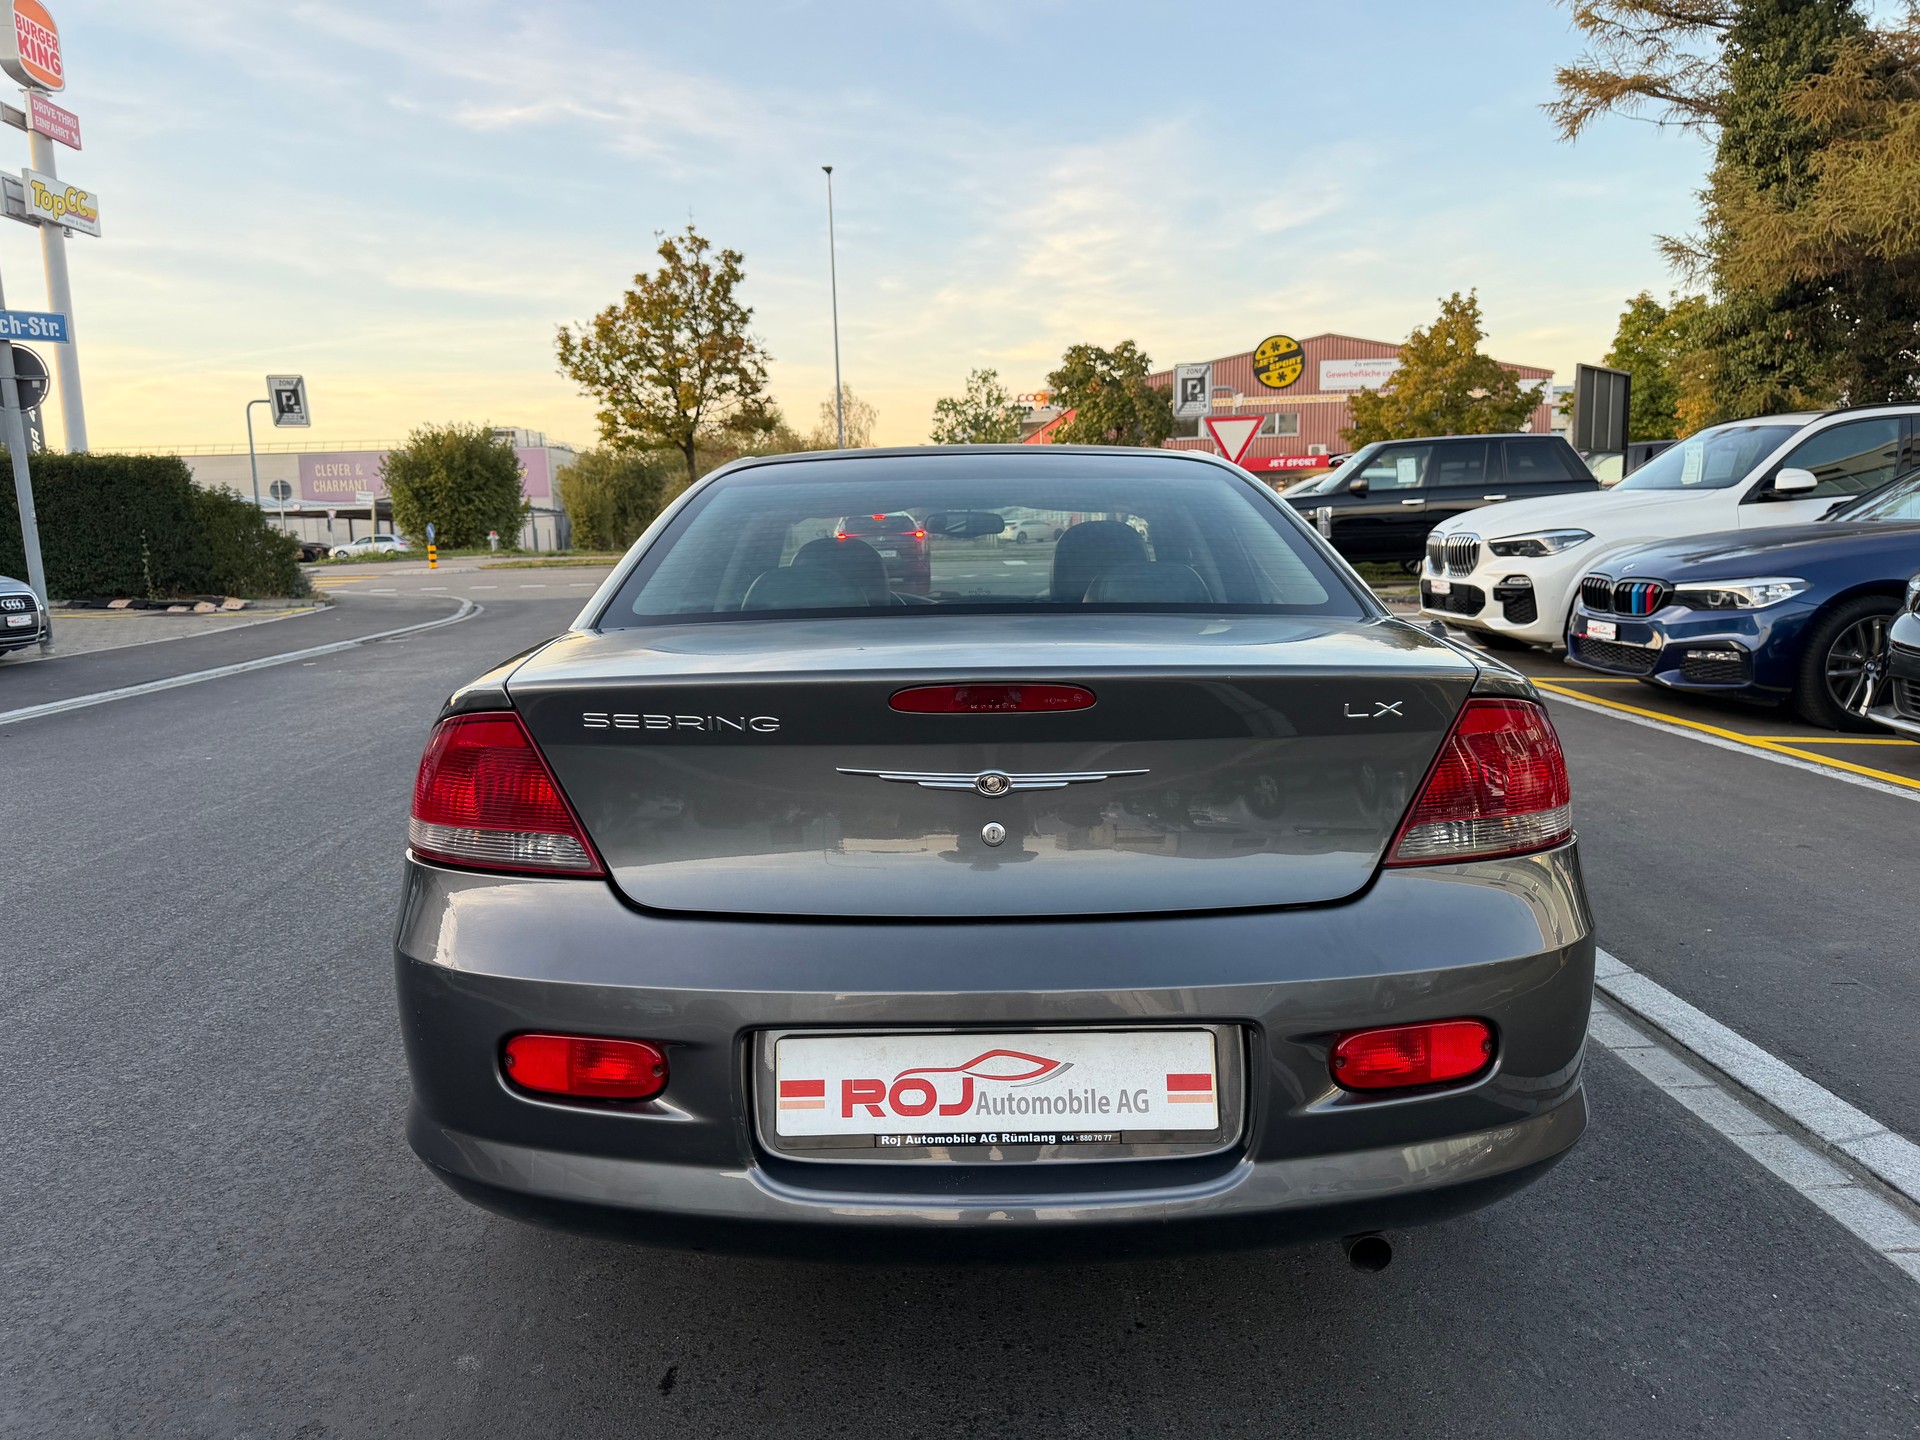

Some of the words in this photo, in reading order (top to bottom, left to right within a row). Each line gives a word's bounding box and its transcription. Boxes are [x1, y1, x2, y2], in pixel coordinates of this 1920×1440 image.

[14, 12, 60, 54] BURGER
[16, 30, 62, 76] KING
[32, 99, 56, 120] DRIVE
[56, 111, 77, 129] THRU
[34, 115, 70, 139] EINFAHRT
[31, 179, 88, 221] TopCC
[1326, 368, 1380, 379] Gewerbefläche
[315, 463, 351, 477] CLEVER
[355, 463, 364, 476] &
[1268, 459, 1285, 467] JET
[1287, 458, 1317, 467] SPORT
[313, 479, 368, 493] CHARMANT
[1343, 700, 1404, 718] LX
[582, 712, 781, 732] SEBRING
[841, 1077, 974, 1118] ROJ
[975, 1088, 1111, 1116] Automobile
[1116, 1088, 1150, 1114] AG
[881, 1135, 901, 1146] Roj
[905, 1134, 977, 1145] Automobile
[979, 1134, 998, 1143] AG
[1001, 1133, 1056, 1144] Rümlang
